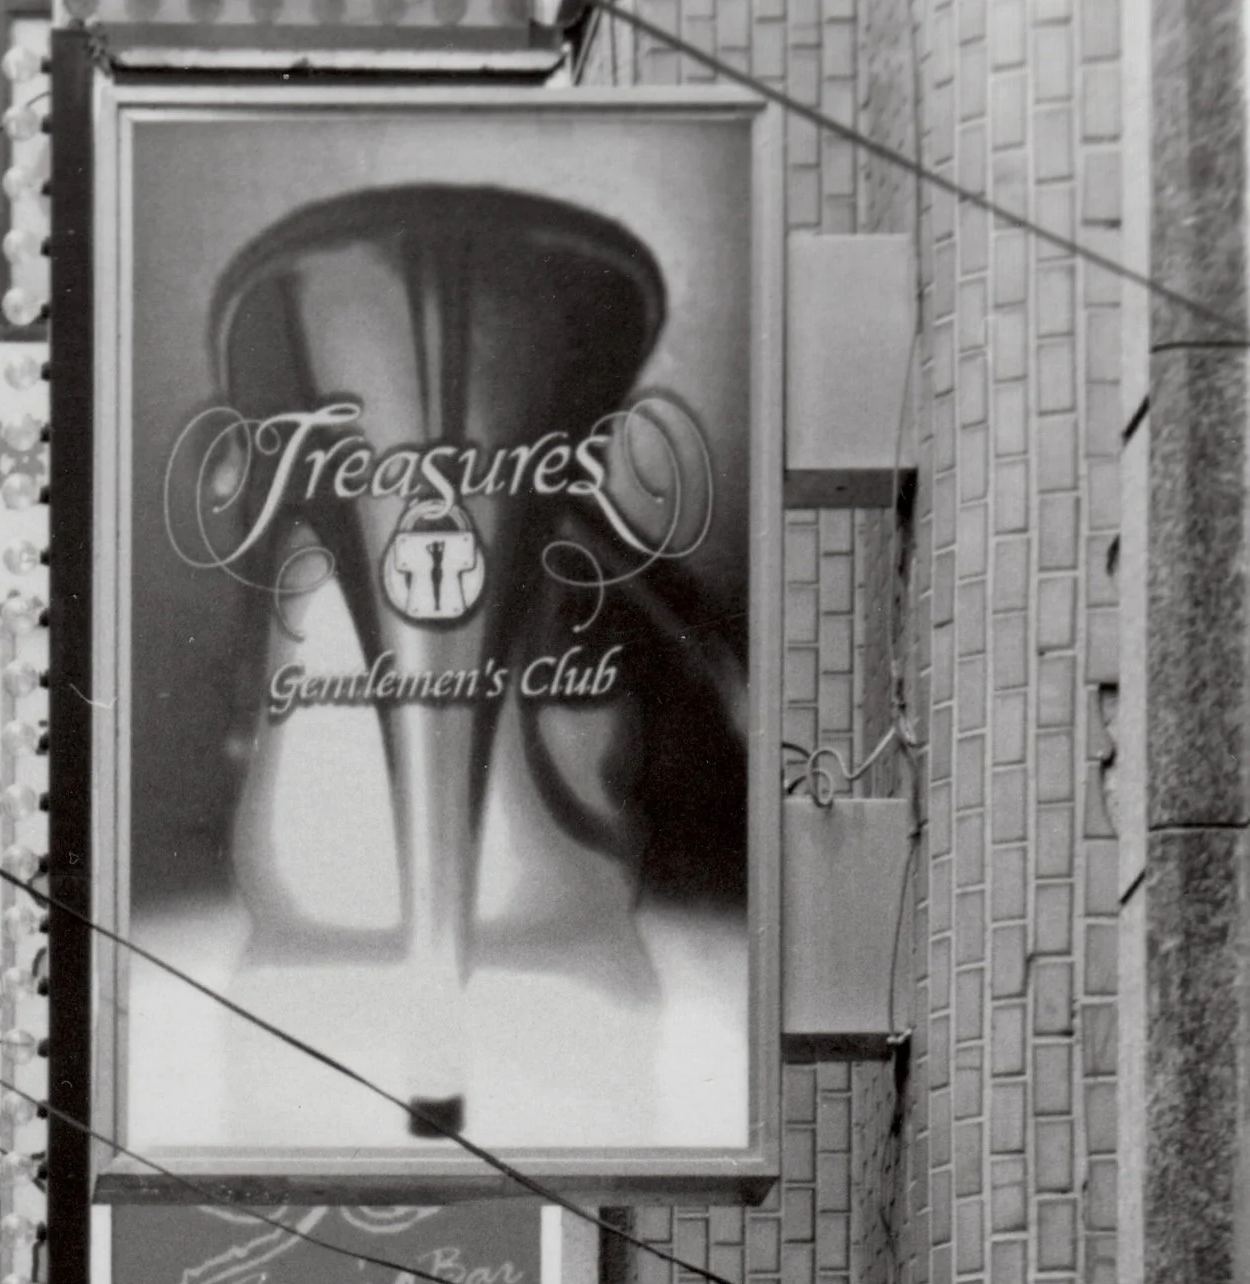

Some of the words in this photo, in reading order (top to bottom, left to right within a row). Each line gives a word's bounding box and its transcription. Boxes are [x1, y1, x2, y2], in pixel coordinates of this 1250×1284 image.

[210, 398, 640, 562] Treasures
[269, 650, 505, 713] Gentlemen's
[520, 646, 623, 696] Club
